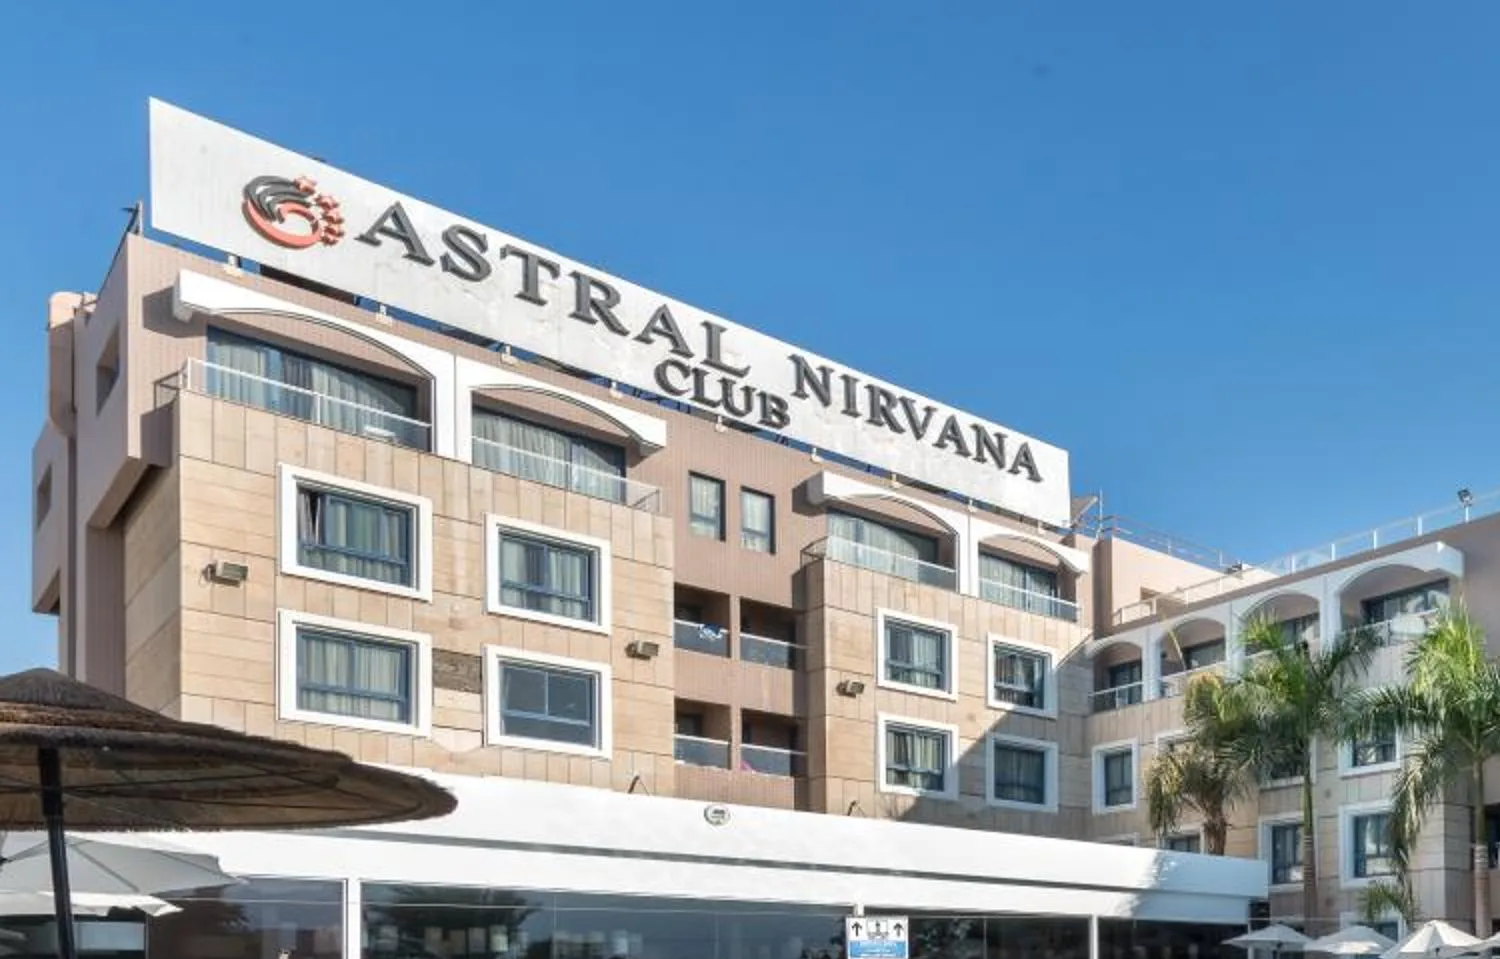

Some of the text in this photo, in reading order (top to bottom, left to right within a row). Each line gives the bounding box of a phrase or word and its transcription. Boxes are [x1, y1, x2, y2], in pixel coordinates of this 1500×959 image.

[354, 201, 1043, 483] ASTRAL NIRVANA
[654, 358, 791, 430] CLUB
